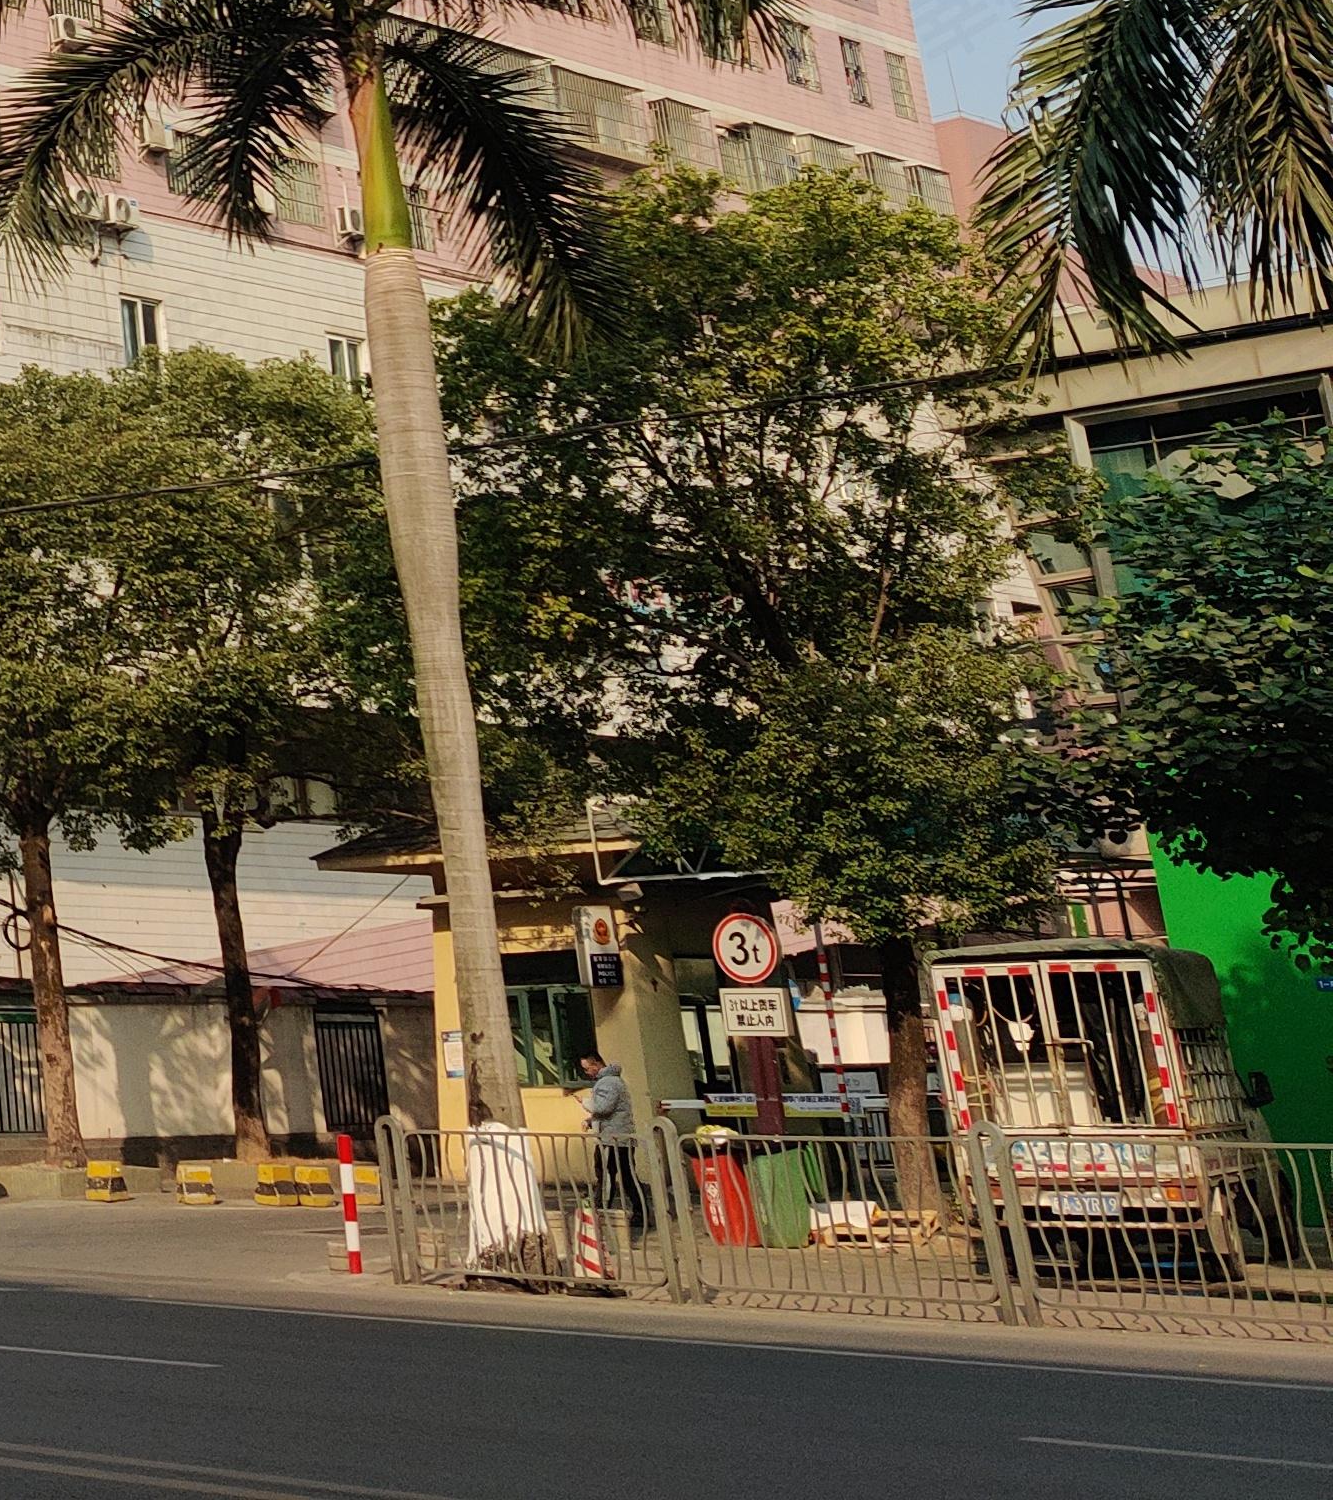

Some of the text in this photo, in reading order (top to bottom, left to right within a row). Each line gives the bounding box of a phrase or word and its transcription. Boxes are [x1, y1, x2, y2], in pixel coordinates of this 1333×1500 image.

[728, 931, 761, 967] 3t
[728, 999, 778, 1012] 3t以上货车
